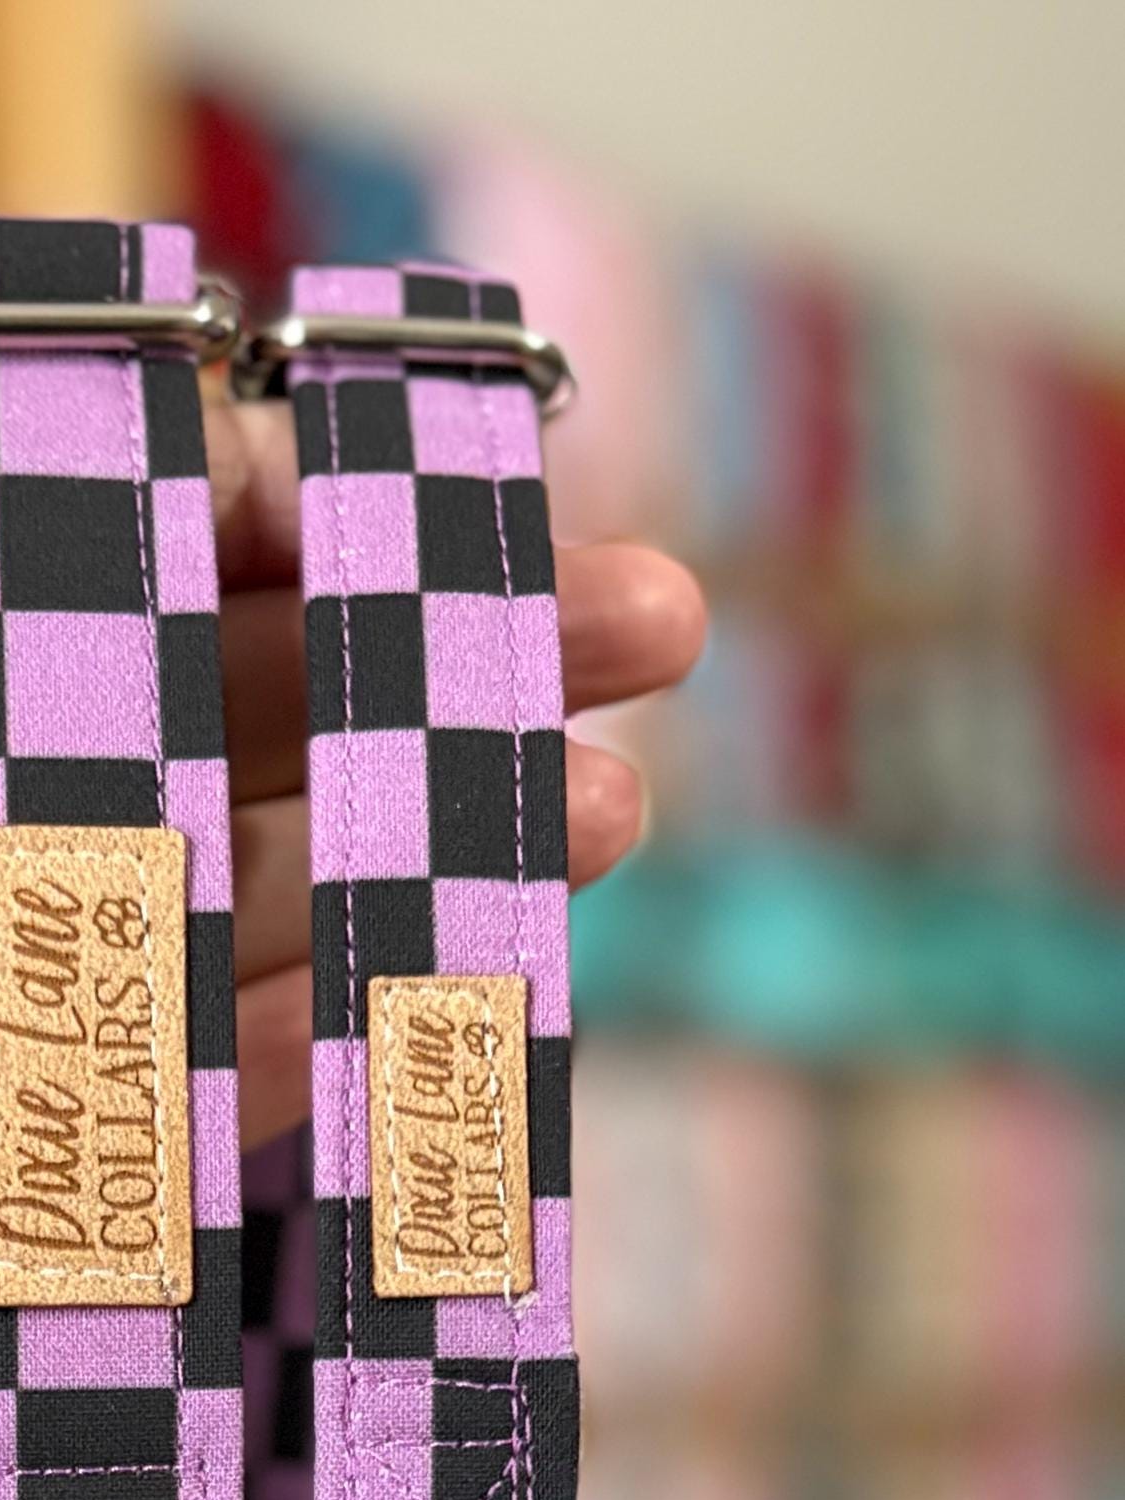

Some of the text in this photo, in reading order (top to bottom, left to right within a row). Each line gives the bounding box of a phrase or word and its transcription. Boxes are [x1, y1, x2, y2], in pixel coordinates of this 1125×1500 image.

[94, 976, 158, 1253] COLLARS
[393, 1009, 466, 1258] Dixie Lane
[464, 1074, 507, 1258] COLLARS
